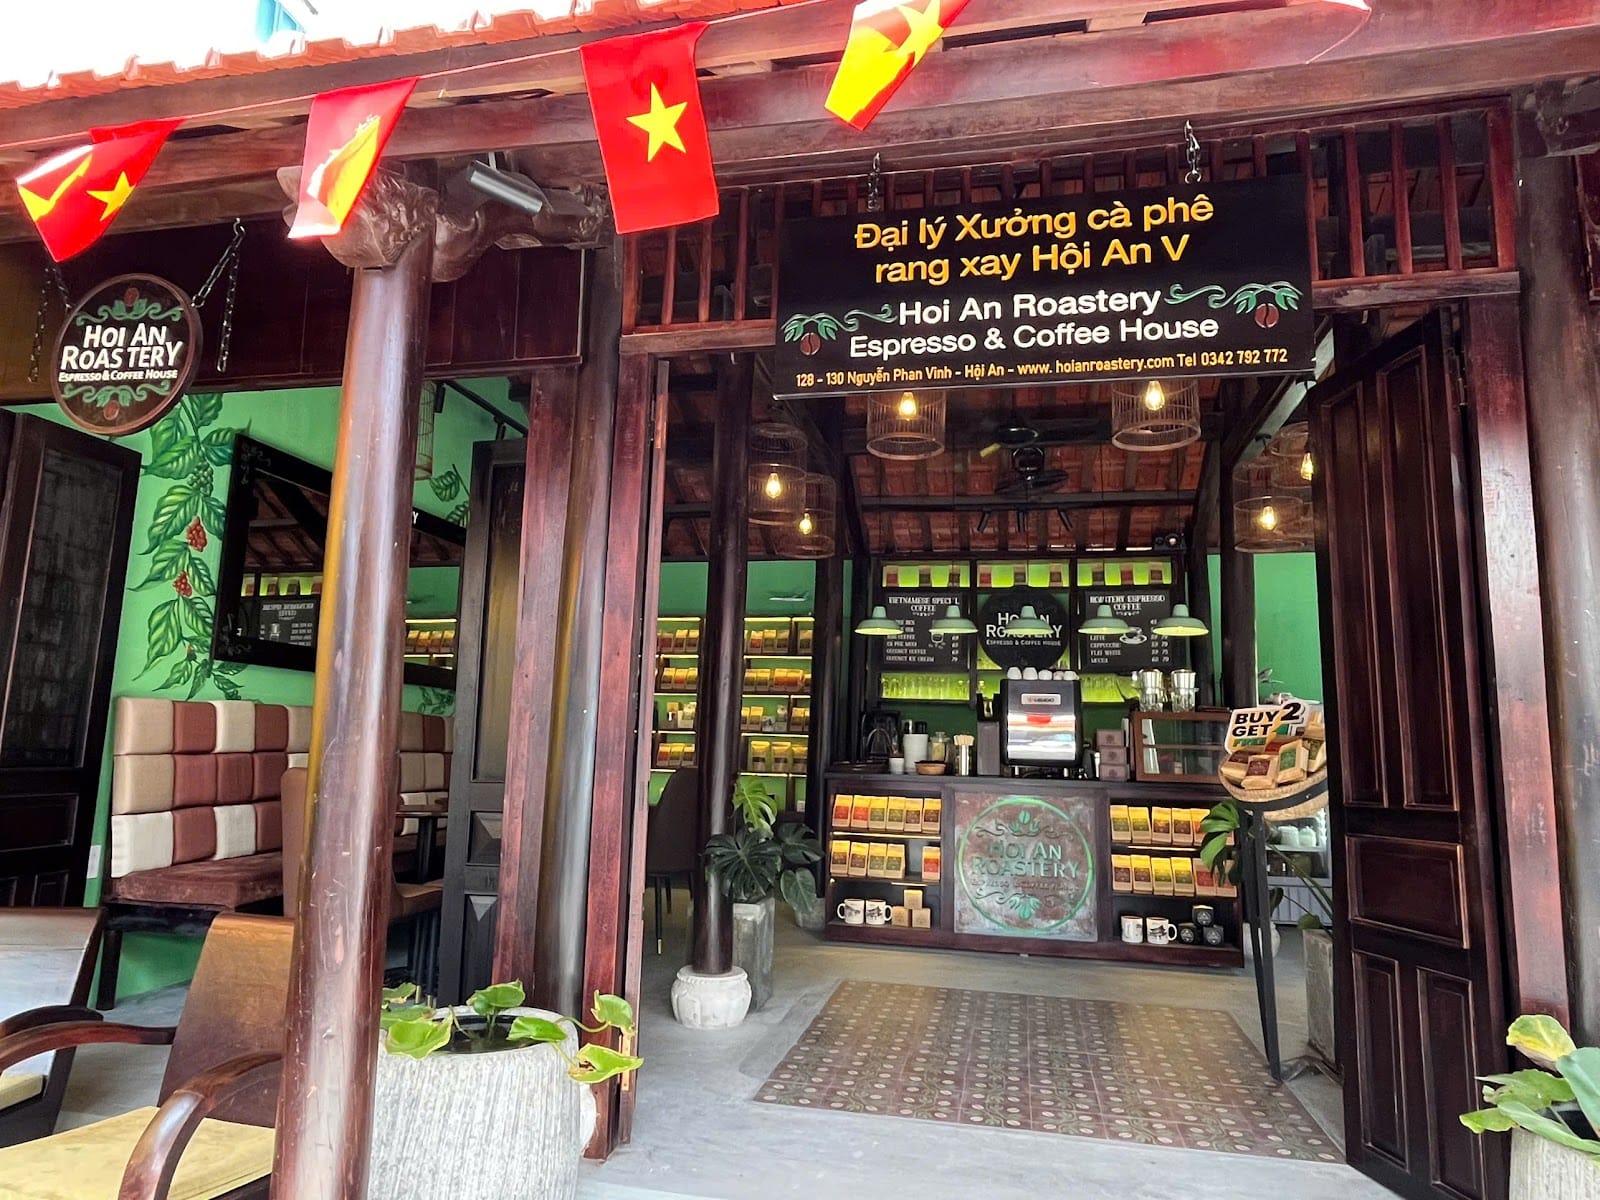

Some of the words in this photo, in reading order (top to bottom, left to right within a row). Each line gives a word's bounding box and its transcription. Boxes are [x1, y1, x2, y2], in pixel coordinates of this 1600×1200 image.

[854, 220, 908, 251] Đại
[919, 216, 947, 250] lý
[955, 208, 1076, 241] Xưởng
[1087, 201, 1133, 230] cà
[1143, 194, 1214, 232] phê
[875, 258, 950, 286] rang
[960, 253, 1022, 281] xay
[1032, 241, 1091, 275] Hội
[1101, 239, 1151, 266] An
[1160, 234, 1190, 261] V
[899, 299, 950, 326] Hoi
[959, 297, 1002, 322] An
[1013, 289, 1162, 318] Roastery
[83, 325, 126, 349] HOI
[130, 323, 167, 346] AN
[850, 333, 977, 361] Espresso
[984, 327, 1006, 350] &
[1013, 321, 1110, 349] Coffee
[1120, 318, 1219, 342] House
[145, 369, 178, 380] HOUSE
[796, 373, 815, 387] 128
[826, 372, 844, 385] 130
[847, 367, 890, 386] Nguyễn
[893, 368, 923, 381] Phan
[925, 366, 953, 380] Vinh
[965, 364, 985, 380] Hội
[988, 363, 1004, 377] An
[1056, 357, 1175, 373] hoianroastery.com
[1177, 352, 1197, 367] Tel
[1201, 351, 1234, 366] 0342
[1236, 350, 1260, 364] 792
[1264, 348, 1288, 363] 772
[911, 604, 936, 612] COFFEE
[931, 597, 960, 605] SPECIL
[1113, 603, 1141, 611] COFFEE
[1234, 710, 1281, 725] BUY
[1280, 702, 1302, 721] 2
[1231, 723, 1273, 737] GET
[988, 840, 1026, 860] HOI
[1033, 841, 1062, 860] AN
[971, 857, 1080, 879] ROASTERY
